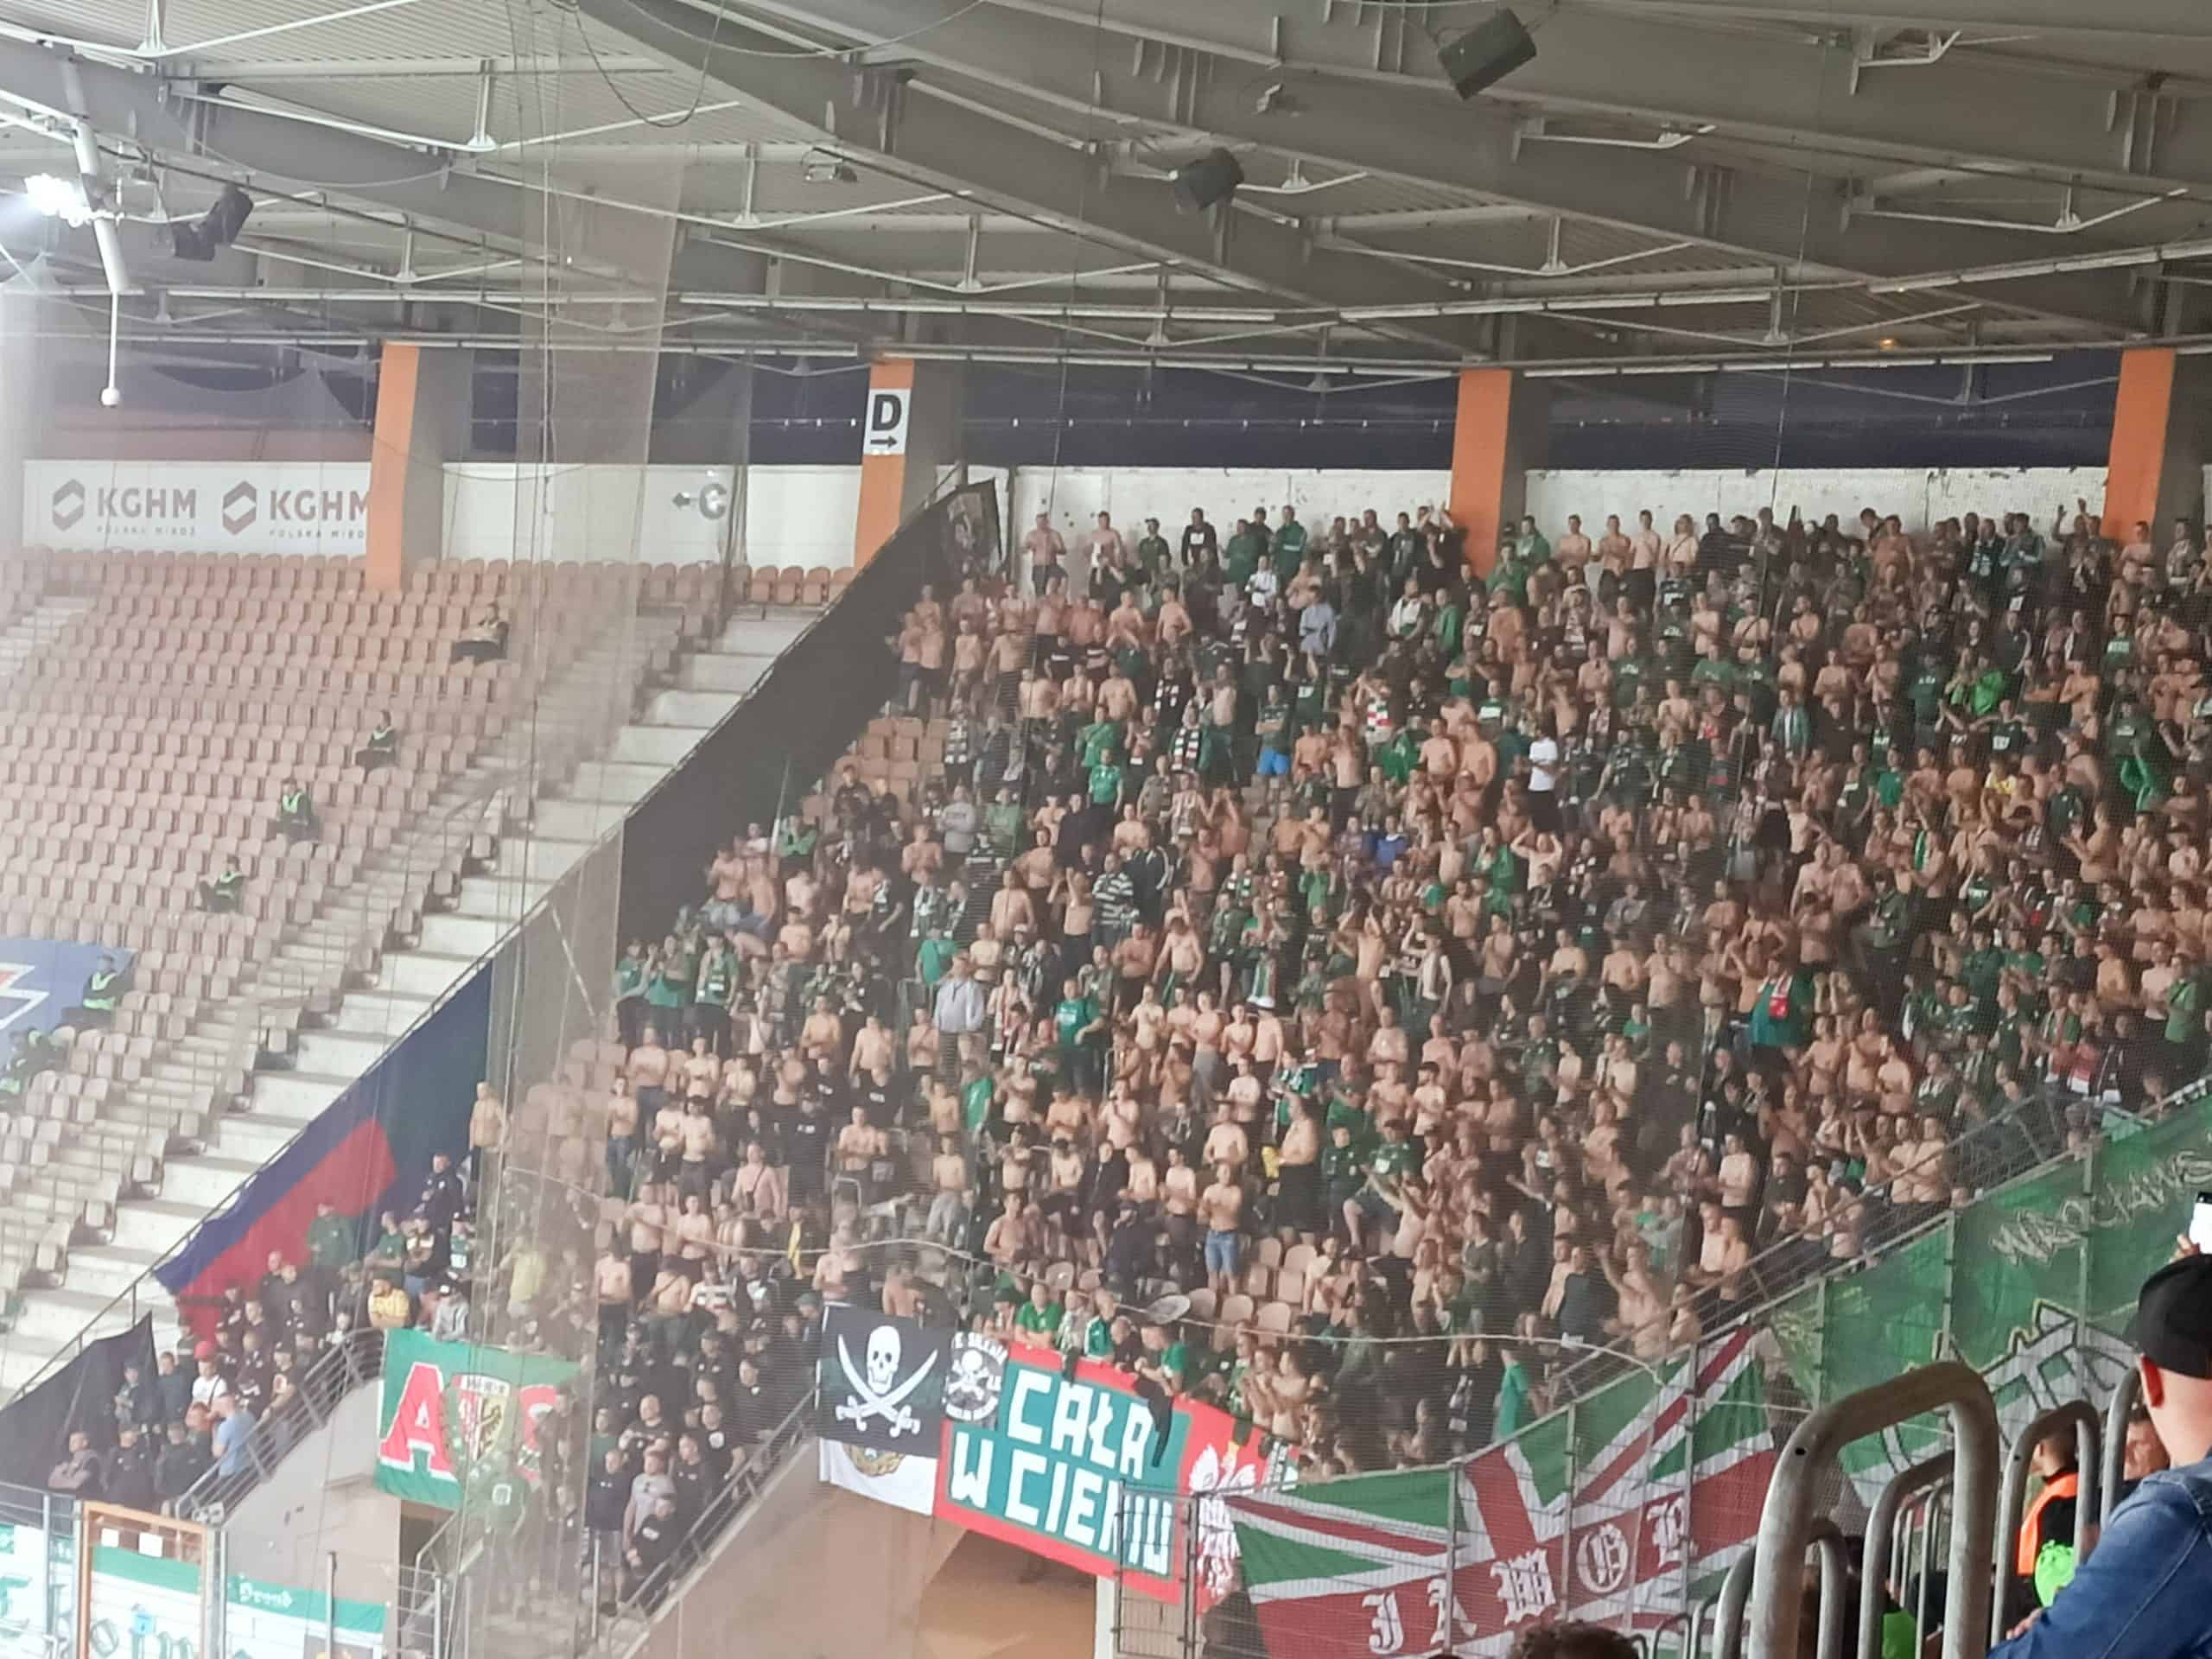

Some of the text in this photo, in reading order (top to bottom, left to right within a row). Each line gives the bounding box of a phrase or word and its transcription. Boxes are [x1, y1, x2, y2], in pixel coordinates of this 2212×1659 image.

[871, 394, 902, 431] D
[97, 486, 197, 518] KGHM
[270, 490, 369, 522] KGHM
[698, 482, 728, 519] C
[1006, 1369, 1154, 1479] CAŁA
[949, 1431, 995, 1510] W
[1004, 1450, 1173, 1576] CIENIU
